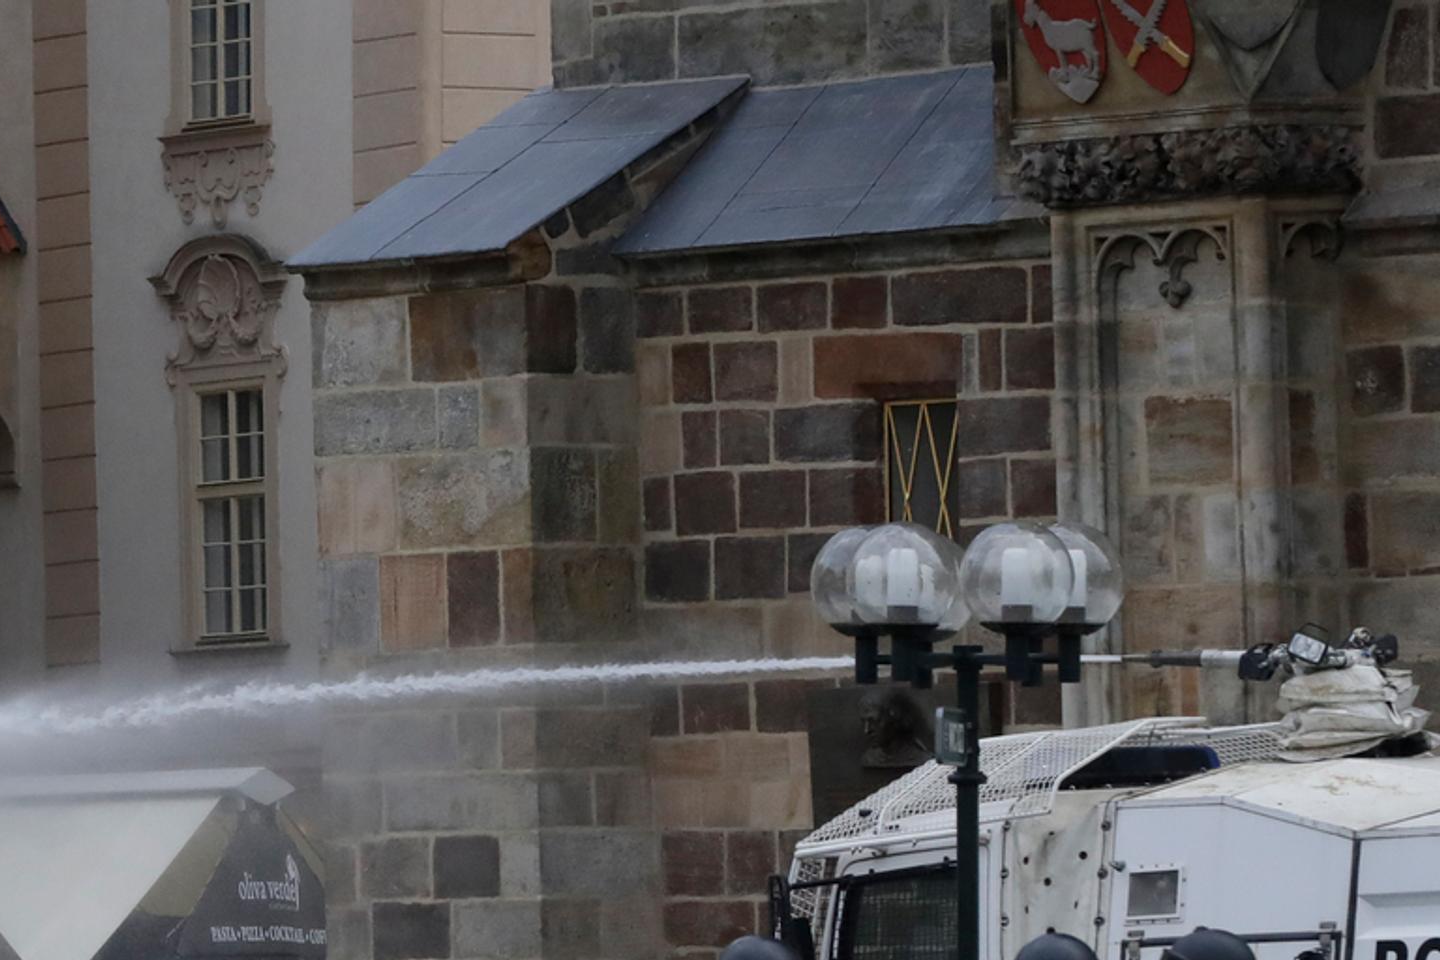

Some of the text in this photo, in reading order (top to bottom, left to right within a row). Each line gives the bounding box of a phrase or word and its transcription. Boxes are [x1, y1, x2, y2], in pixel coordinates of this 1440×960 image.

[238, 872, 296, 902] oliva verde
[210, 925, 238, 943] PASTA
[240, 925, 266, 942] PIZZA
[269, 925, 305, 944] COCKTAIL
